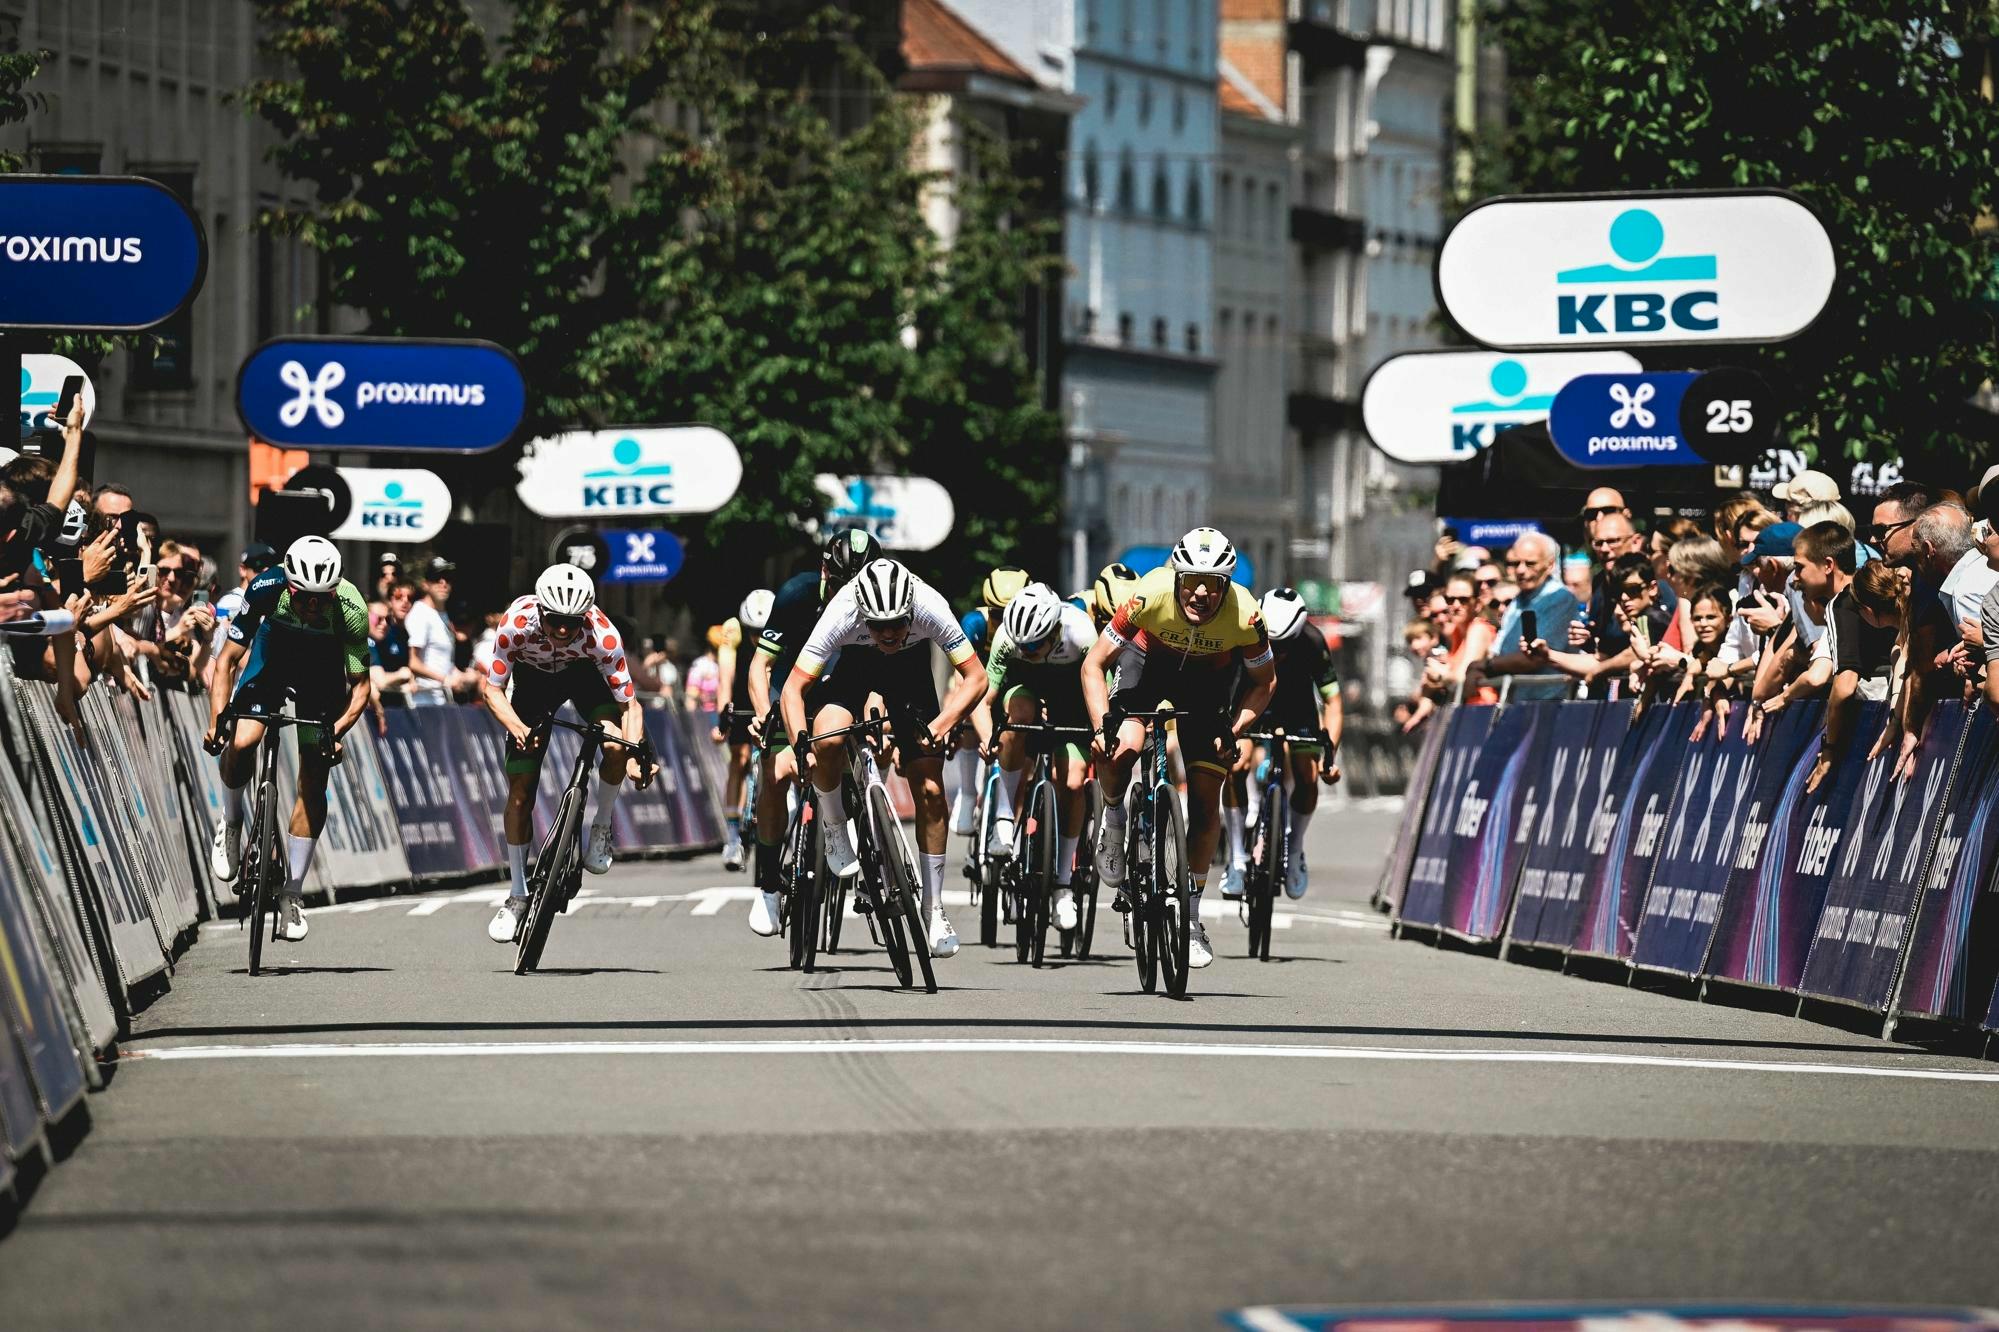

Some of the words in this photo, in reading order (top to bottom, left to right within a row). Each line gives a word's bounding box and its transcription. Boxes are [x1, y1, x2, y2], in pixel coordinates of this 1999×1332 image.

[1557, 291, 1719, 335] KBC
[357, 381, 486, 410] proximus
[1705, 400, 1753, 433] 25
[1588, 435, 1678, 456] proximus
[584, 484, 673, 507] KBC
[362, 512, 424, 528] KBC
[1158, 630, 1225, 650] CRABBE
[1734, 800, 1768, 870] fiber
[1795, 804, 1841, 876] fiber
